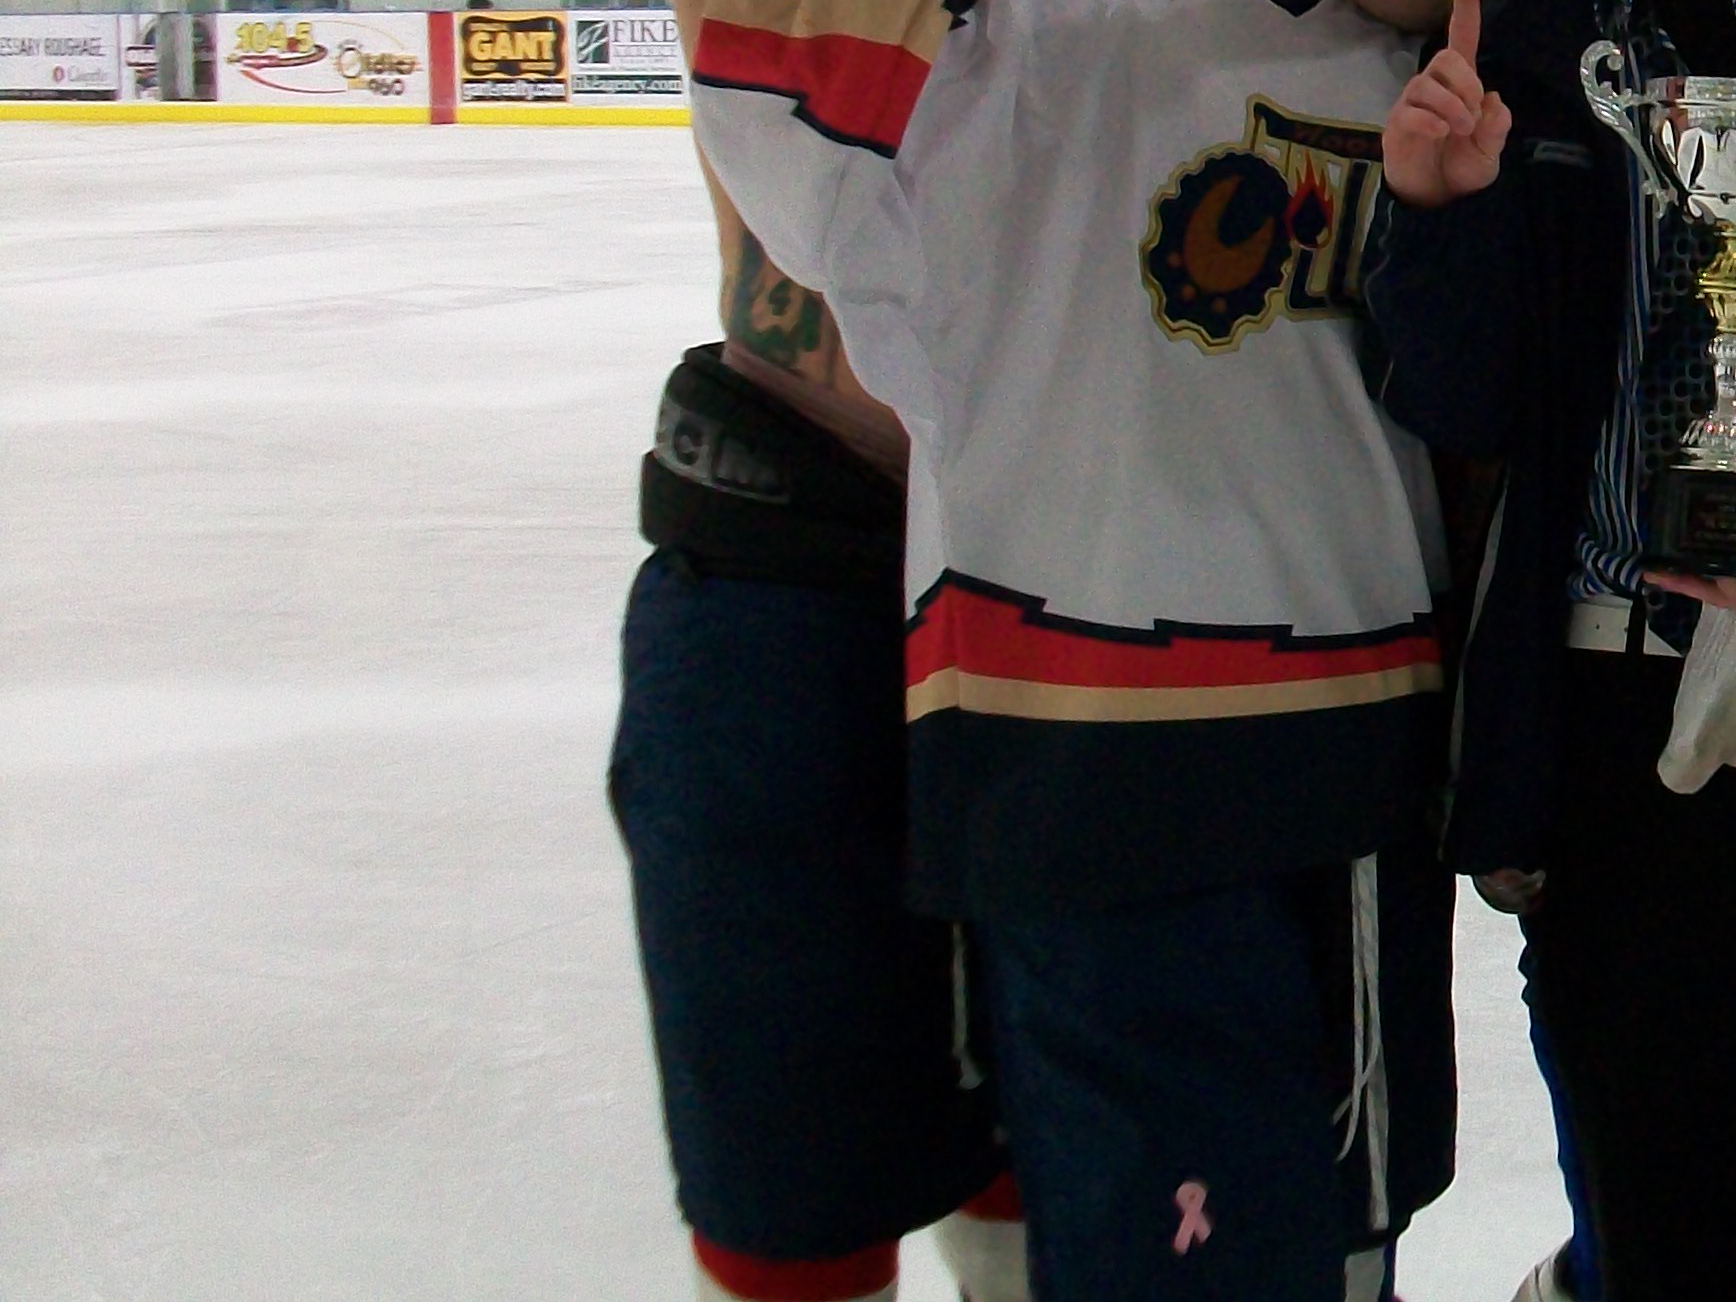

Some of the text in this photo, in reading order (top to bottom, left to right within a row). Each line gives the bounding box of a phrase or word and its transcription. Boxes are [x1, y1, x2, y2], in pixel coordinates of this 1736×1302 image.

[612, 19, 679, 43] FIKE
[0, 37, 40, 56] ESSARY
[469, 30, 557, 61] GANT
